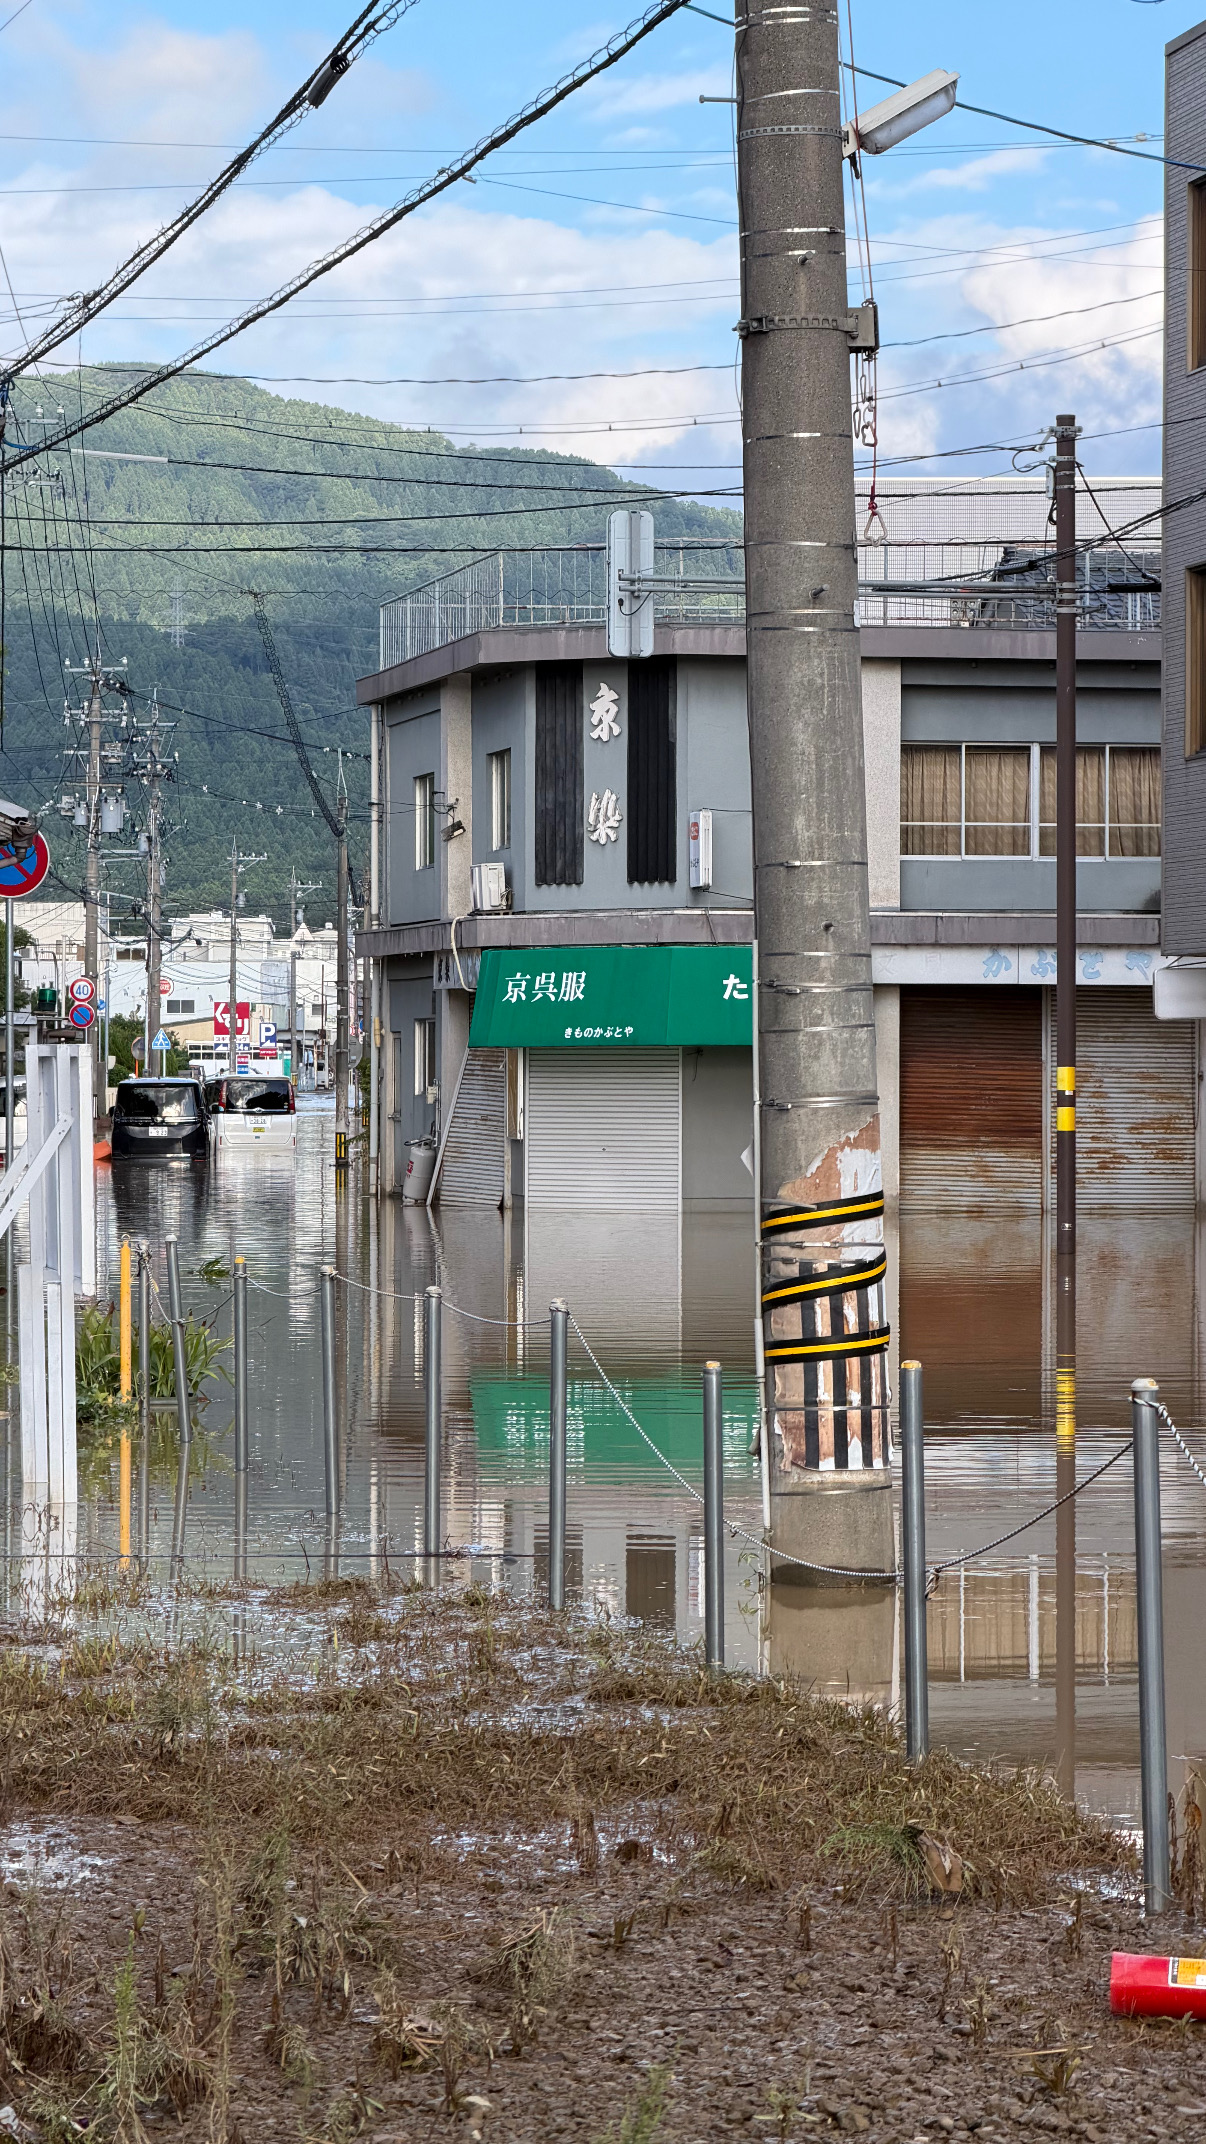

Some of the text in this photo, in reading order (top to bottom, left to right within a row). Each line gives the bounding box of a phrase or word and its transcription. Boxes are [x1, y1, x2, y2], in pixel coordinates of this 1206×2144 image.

[75, 984, 89, 996] 40
[501, 970, 587, 1004] 京呉服
[722, 973, 749, 1000] た
[260, 1023, 276, 1043] P
[564, 1026, 634, 1039] きものかぶとや
